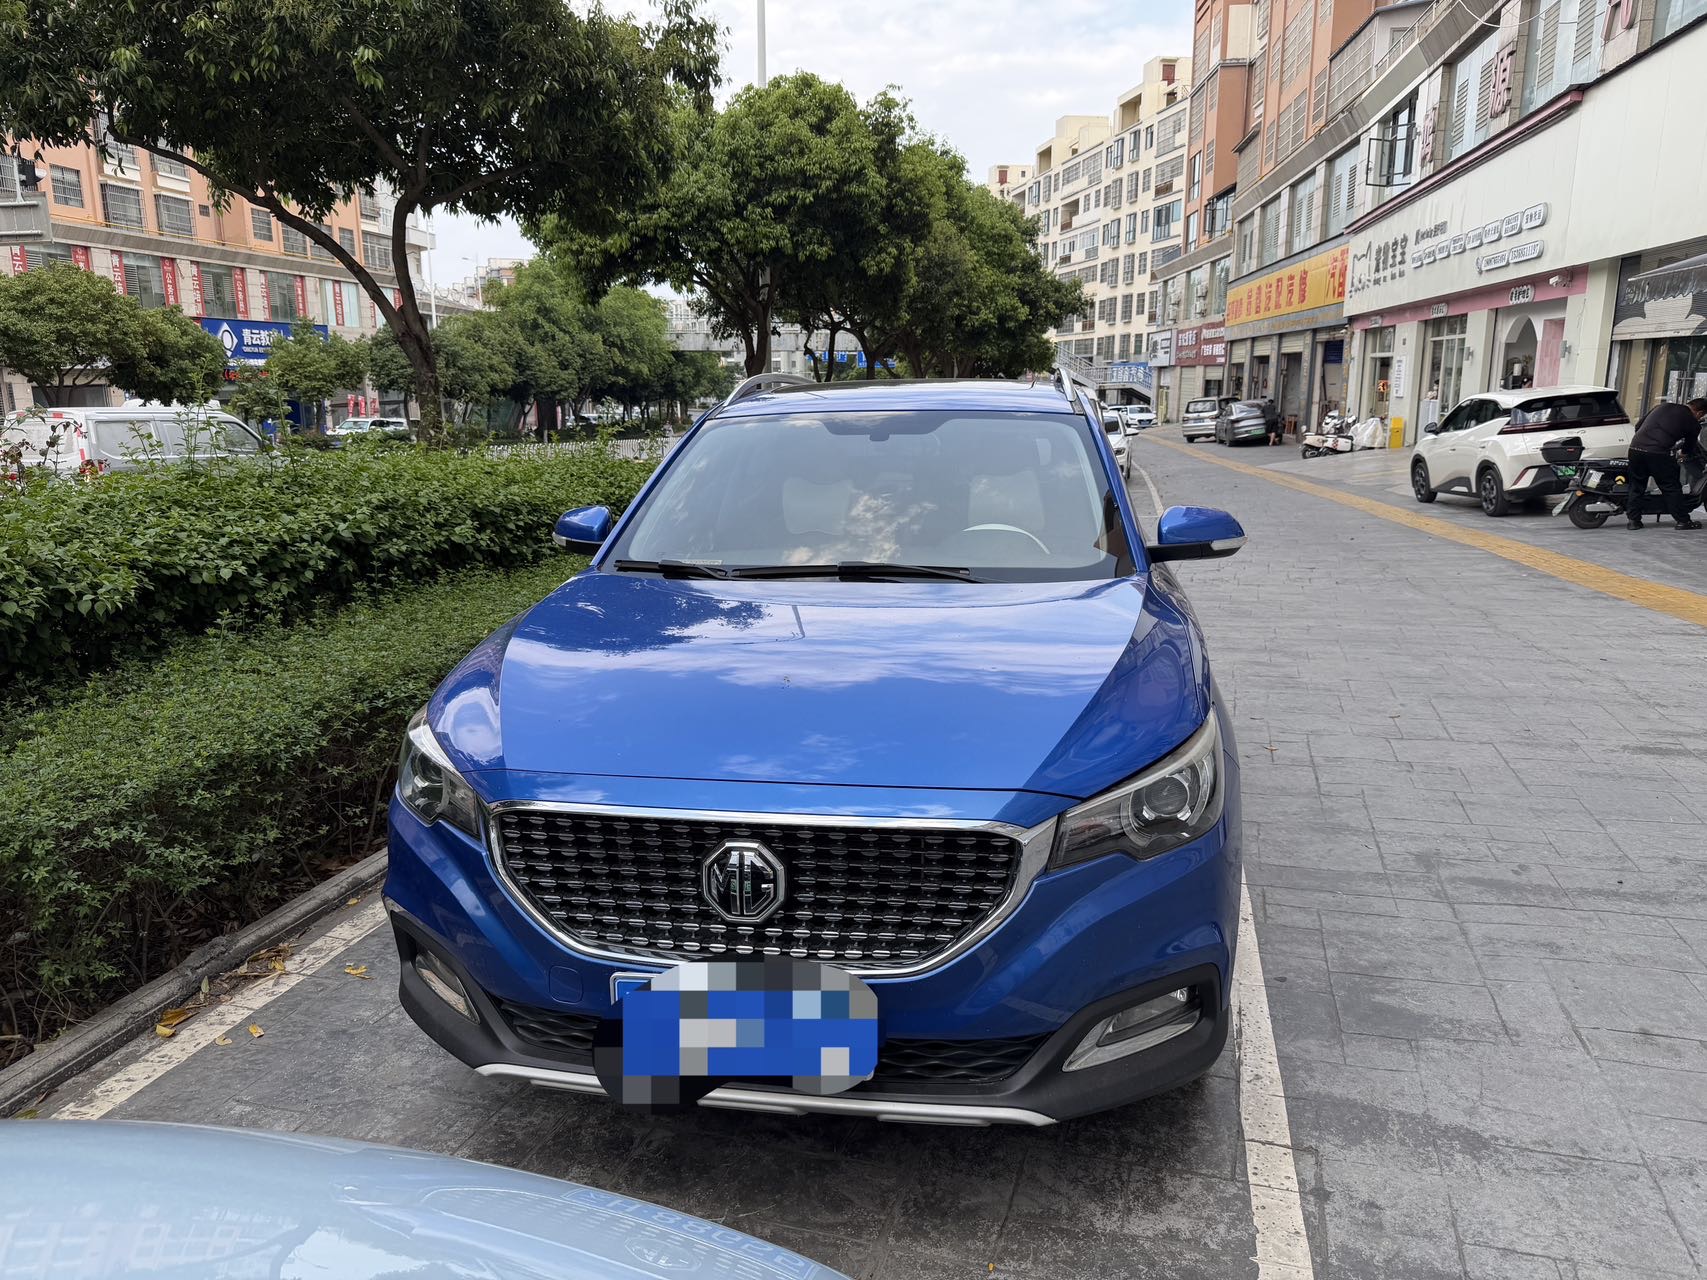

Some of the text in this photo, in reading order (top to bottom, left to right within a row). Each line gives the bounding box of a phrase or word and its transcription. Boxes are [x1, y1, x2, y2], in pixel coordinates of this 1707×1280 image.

[242, 328, 281, 346] 青云教
[709, 850, 775, 915] MG
